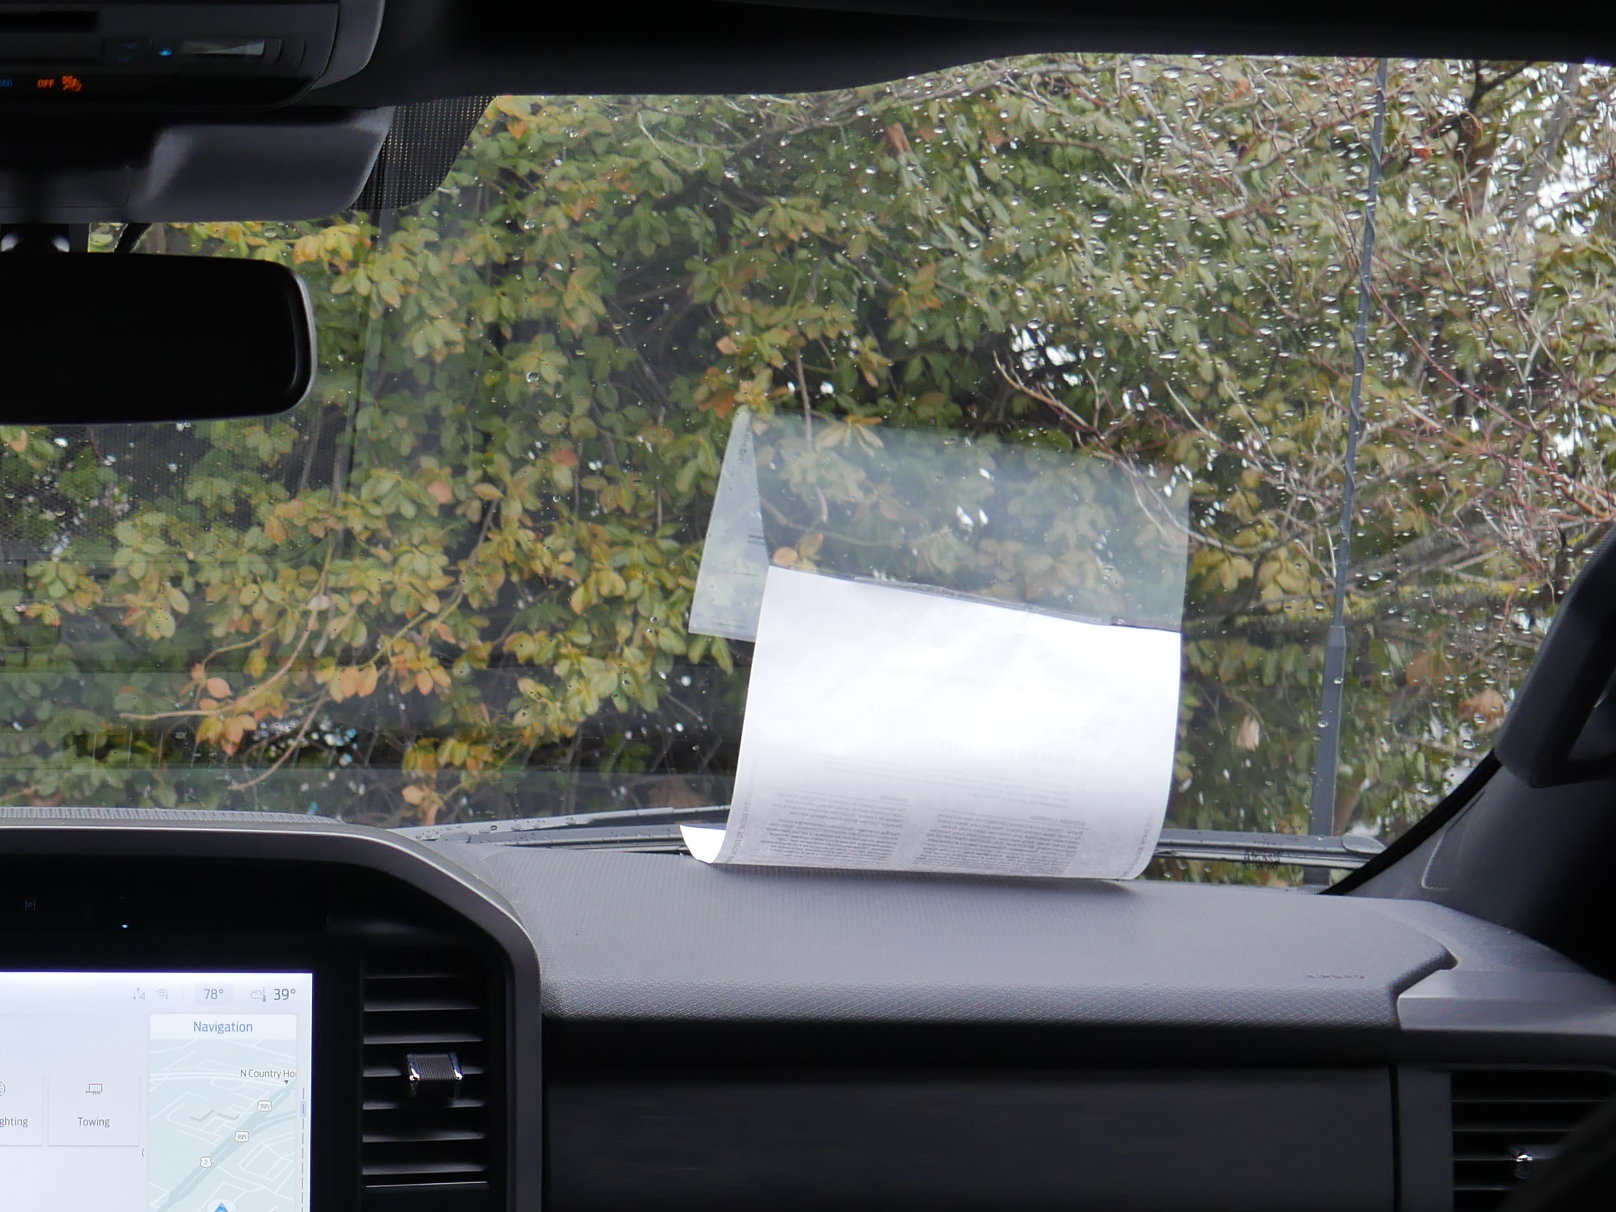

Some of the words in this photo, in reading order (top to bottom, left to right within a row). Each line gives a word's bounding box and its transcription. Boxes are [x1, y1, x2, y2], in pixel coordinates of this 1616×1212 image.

[37, 78, 55, 88] OFF
[203, 988, 224, 1000] 78°
[273, 988, 297, 1001] 39°
[193, 1021, 253, 1035] Navigation
[240, 1069, 247, 1078] N
[248, 1069, 282, 1079] Country
[77, 1117, 111, 1129] Towing
